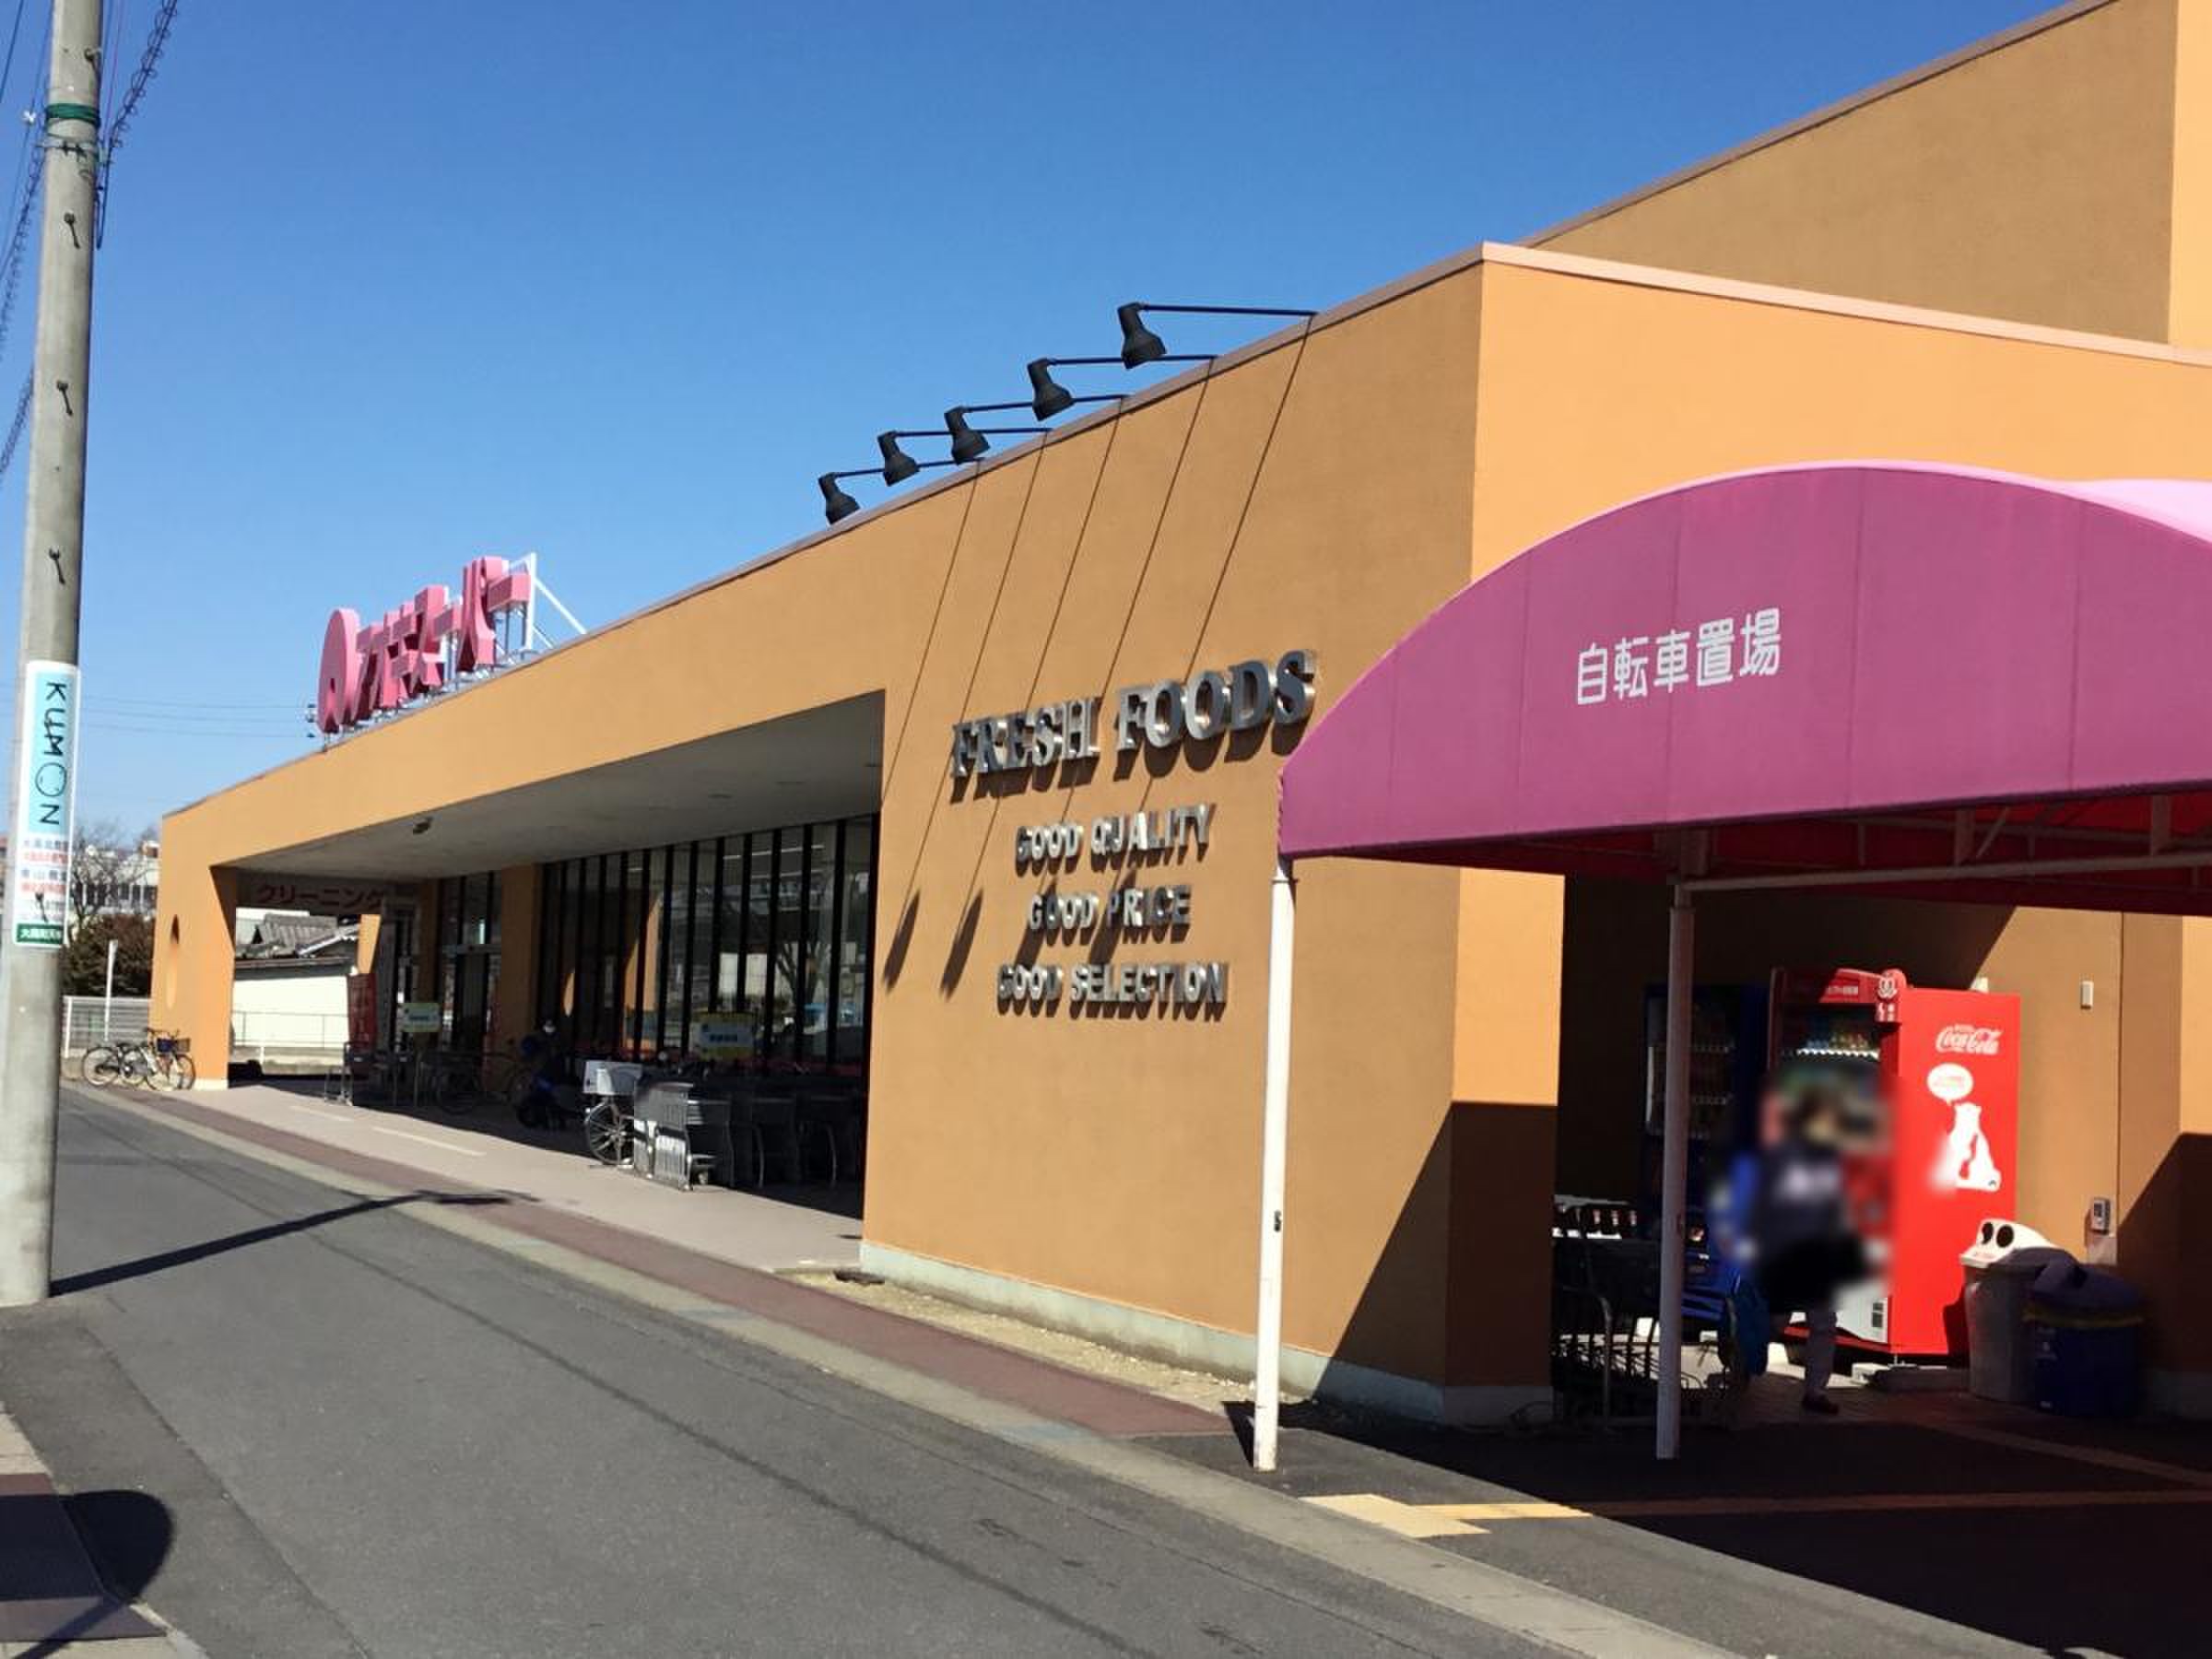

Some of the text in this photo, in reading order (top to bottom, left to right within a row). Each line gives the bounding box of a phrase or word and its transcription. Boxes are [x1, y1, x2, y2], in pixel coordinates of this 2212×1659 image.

[1577, 607, 1781, 705] 自転車置場
[951, 648, 1317, 777] FRESH FOODS
[35, 682, 67, 825] KUMON
[1017, 804, 1213, 863] GOOD QUALITY
[257, 884, 384, 910] クリーニング
[1030, 885, 1191, 931] GOOD PRICE
[997, 961, 1227, 1009] GOOD SELECTION
